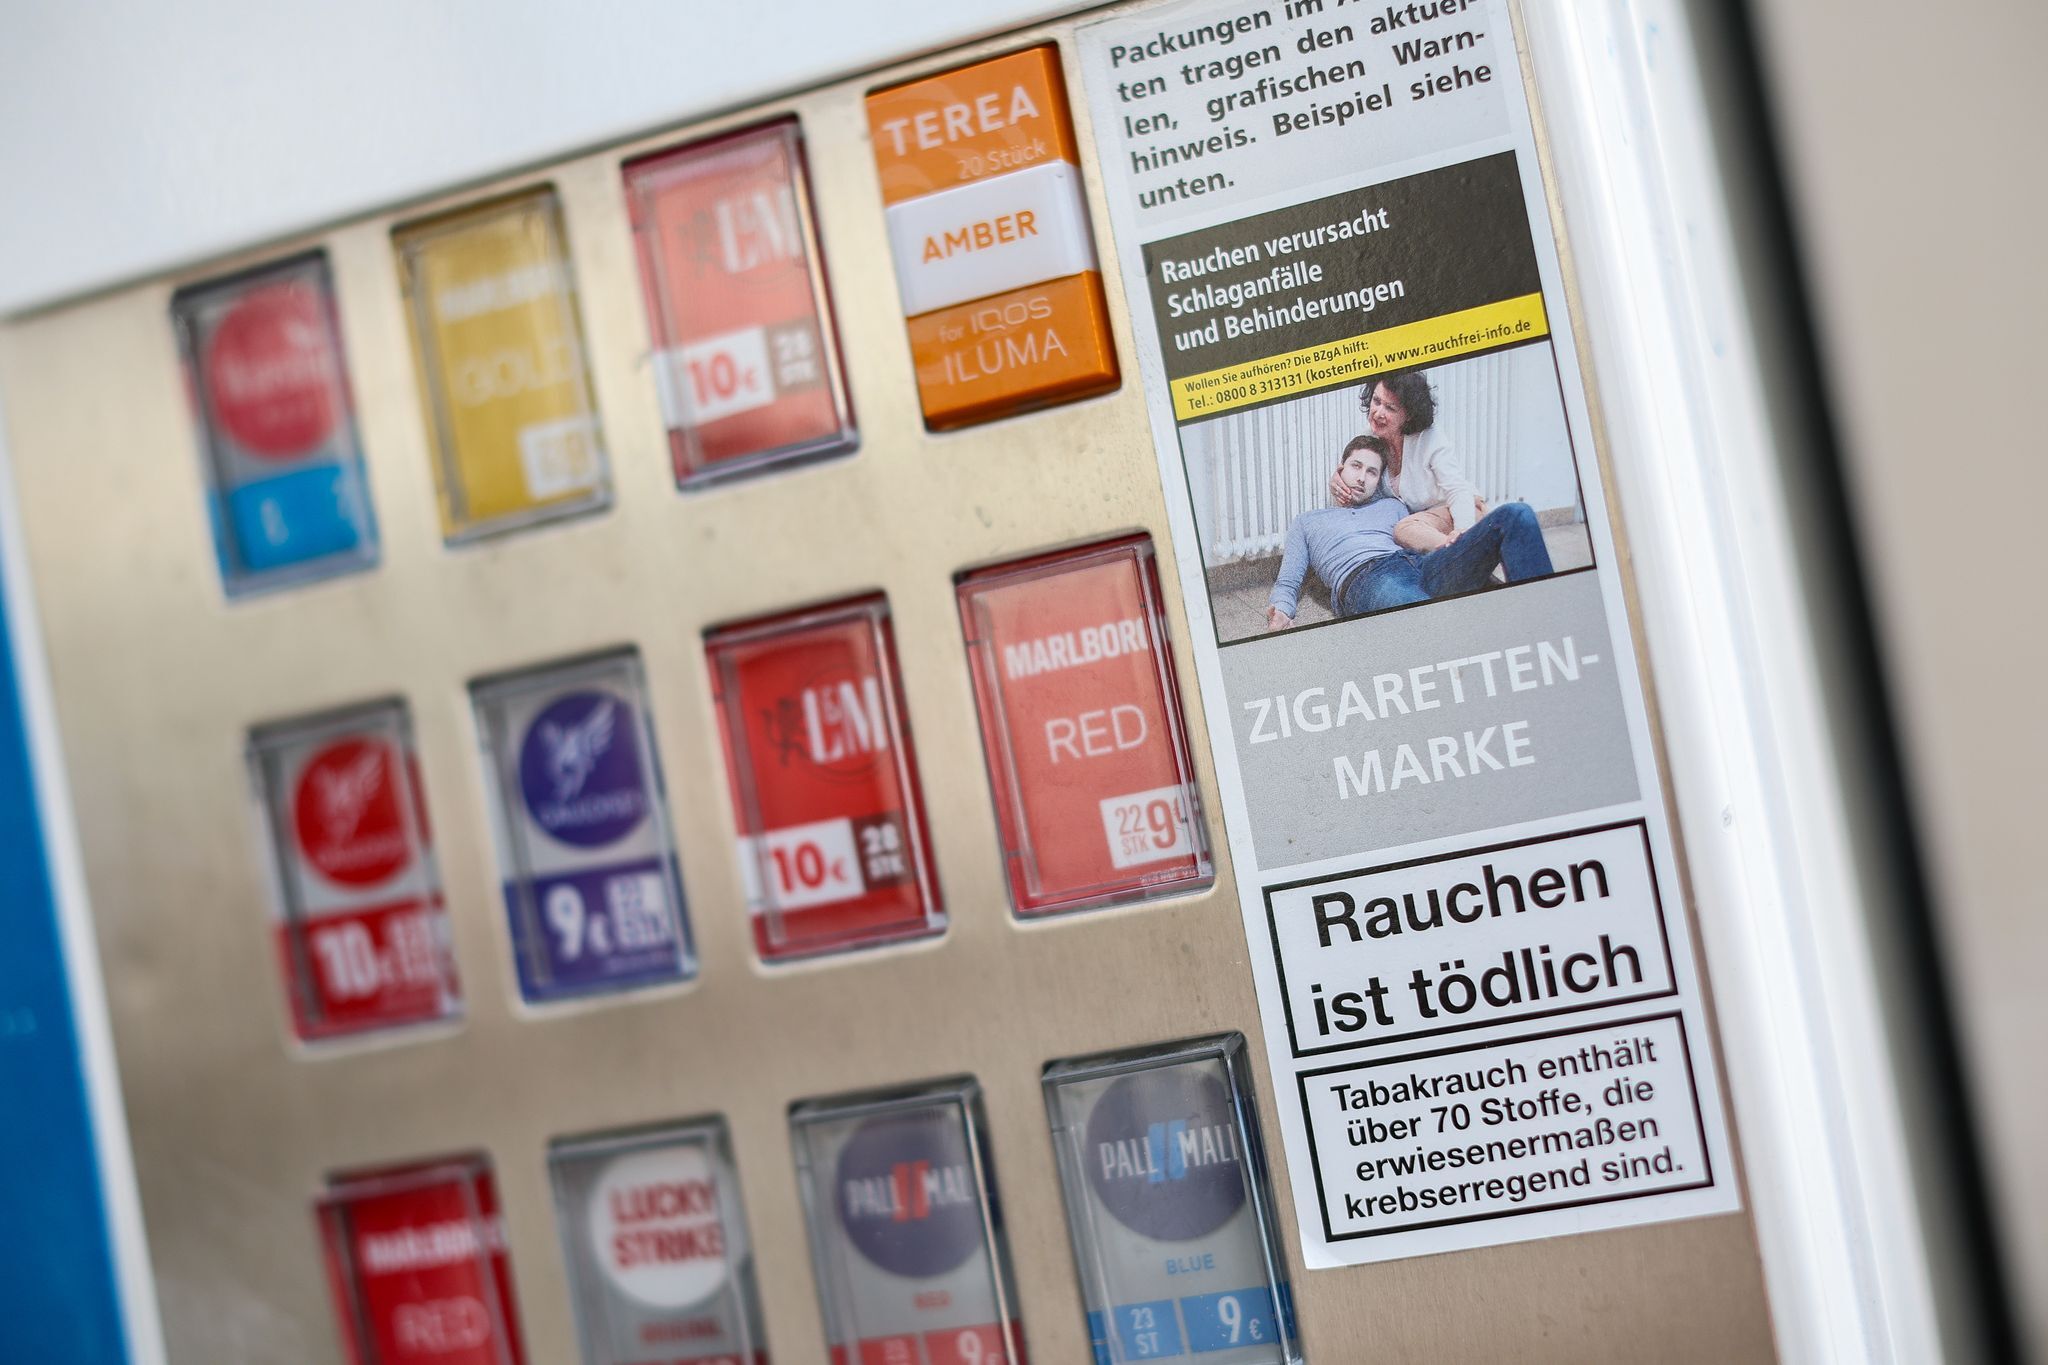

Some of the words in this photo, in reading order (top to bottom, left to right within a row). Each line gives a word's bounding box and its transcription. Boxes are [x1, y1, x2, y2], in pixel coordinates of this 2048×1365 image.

[1110, 6, 1272, 68] Packungen
[1286, 0, 1323, 20] im
[1117, 75, 1167, 102] ten
[1181, 43, 1281, 86] tragen
[1297, 24, 1354, 54] den
[1124, 112, 1179, 139] len,
[1206, 55, 1366, 126] grafischen
[1392, 29, 1486, 66] Warn-
[883, 86, 1040, 156] TEREA
[1130, 126, 1257, 175] hinweis.
[1272, 84, 1394, 137] Beispiel
[1410, 63, 1492, 101] siehe
[957, 156, 983, 180] 20
[987, 138, 1047, 173] Stück
[1138, 169, 1235, 210] unten.
[922, 209, 1039, 264] AMBER
[1160, 241, 1260, 284] Rauchen
[1264, 207, 1390, 259] verursacht
[939, 322, 965, 344] for
[970, 296, 1053, 335] IQOS
[1167, 260, 1323, 318] Schlaganfälle
[1175, 319, 1219, 352] und
[1223, 278, 1405, 337] Behinderungen
[944, 329, 1068, 385] ILUMA
[1184, 374, 1221, 393] Wollen
[1222, 370, 1238, 384] Sie
[1240, 360, 1292, 381] aufhören?
[1293, 354, 1312, 368] Die
[1313, 346, 1342, 365] BZgA
[1342, 340, 1369, 357] hilft:
[1187, 396, 1214, 411] Tel.:
[1216, 387, 1247, 404] 0800
[1249, 383, 1258, 397] 8
[1259, 372, 1303, 395] 313131
[1305, 354, 1384, 385] (kostenfrei),
[1384, 319, 1532, 366] www.rauchfrei-info.de
[1243, 636, 1599, 745] ZIGARETTEN-
[1044, 704, 1149, 764] RED
[1333, 719, 1535, 800] MARKE
[1114, 804, 1145, 835] 22
[1121, 833, 1149, 856] STK
[1311, 858, 1610, 948] Rauchen
[1310, 977, 1395, 1037] ist
[1409, 934, 1643, 1018] tödlich
[1330, 1058, 1527, 1112] Tabakrauch
[1537, 1036, 1658, 1080] enthält
[1346, 1114, 1422, 1147] über
[1430, 1103, 1471, 1133] 70
[1481, 1083, 1593, 1126] Stoffe,
[1603, 1077, 1654, 1109] die
[1100, 1137, 1158, 1180] PALL
[1344, 1159, 1591, 1220] krebserregend
[1601, 1145, 1684, 1182] sind.
[1356, 1116, 1659, 1182] erwiesenermaßen
[1166, 1253, 1216, 1276] BLUE
[1131, 1307, 1156, 1331] 23
[1135, 1333, 1158, 1355] ST
